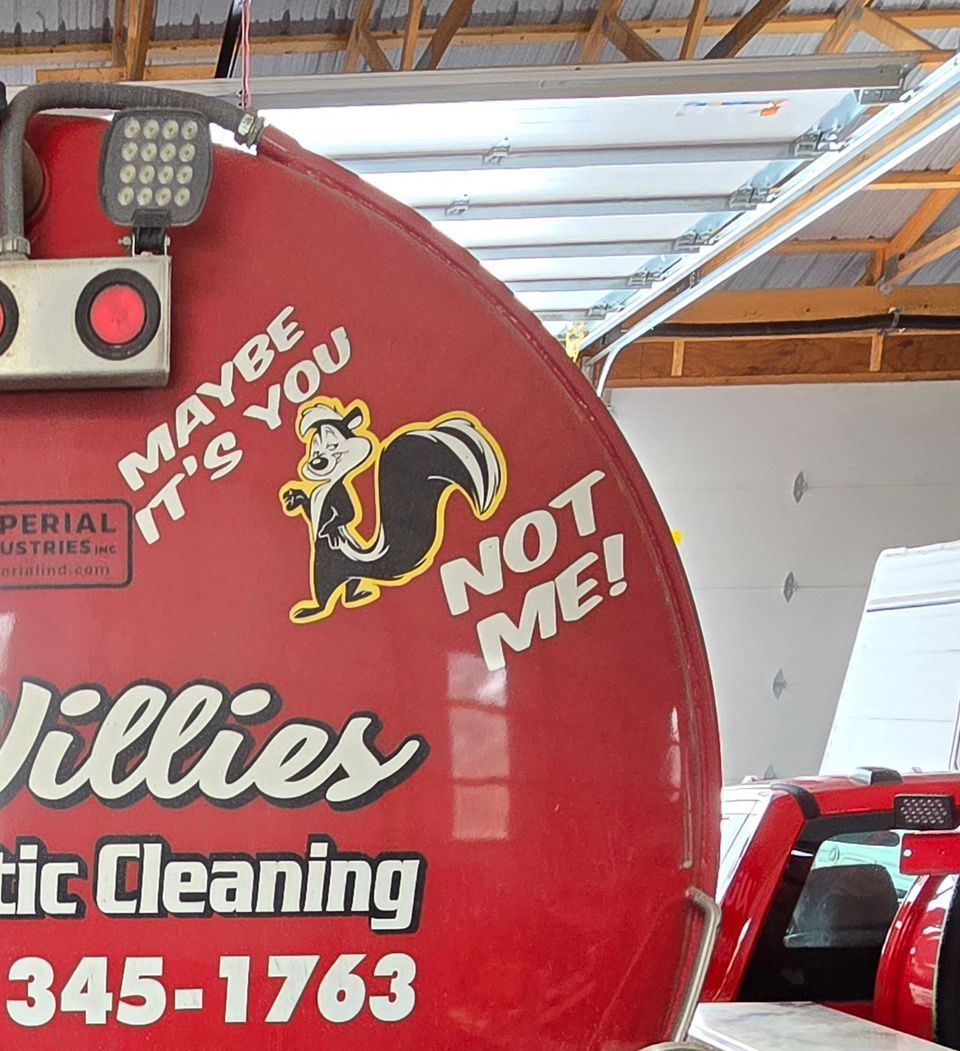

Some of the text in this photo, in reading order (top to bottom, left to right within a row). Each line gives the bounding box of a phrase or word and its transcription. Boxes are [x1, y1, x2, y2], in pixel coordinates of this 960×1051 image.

[118, 306, 303, 491] MAYBE
[135, 327, 351, 544] IT'S YOU
[95, 545, 117, 555] INC
[440, 470, 606, 616] NOT
[477, 534, 627, 671] ME!
[93, 837, 426, 933] Cleaning
[6, 952, 417, 1027] 345-1763
